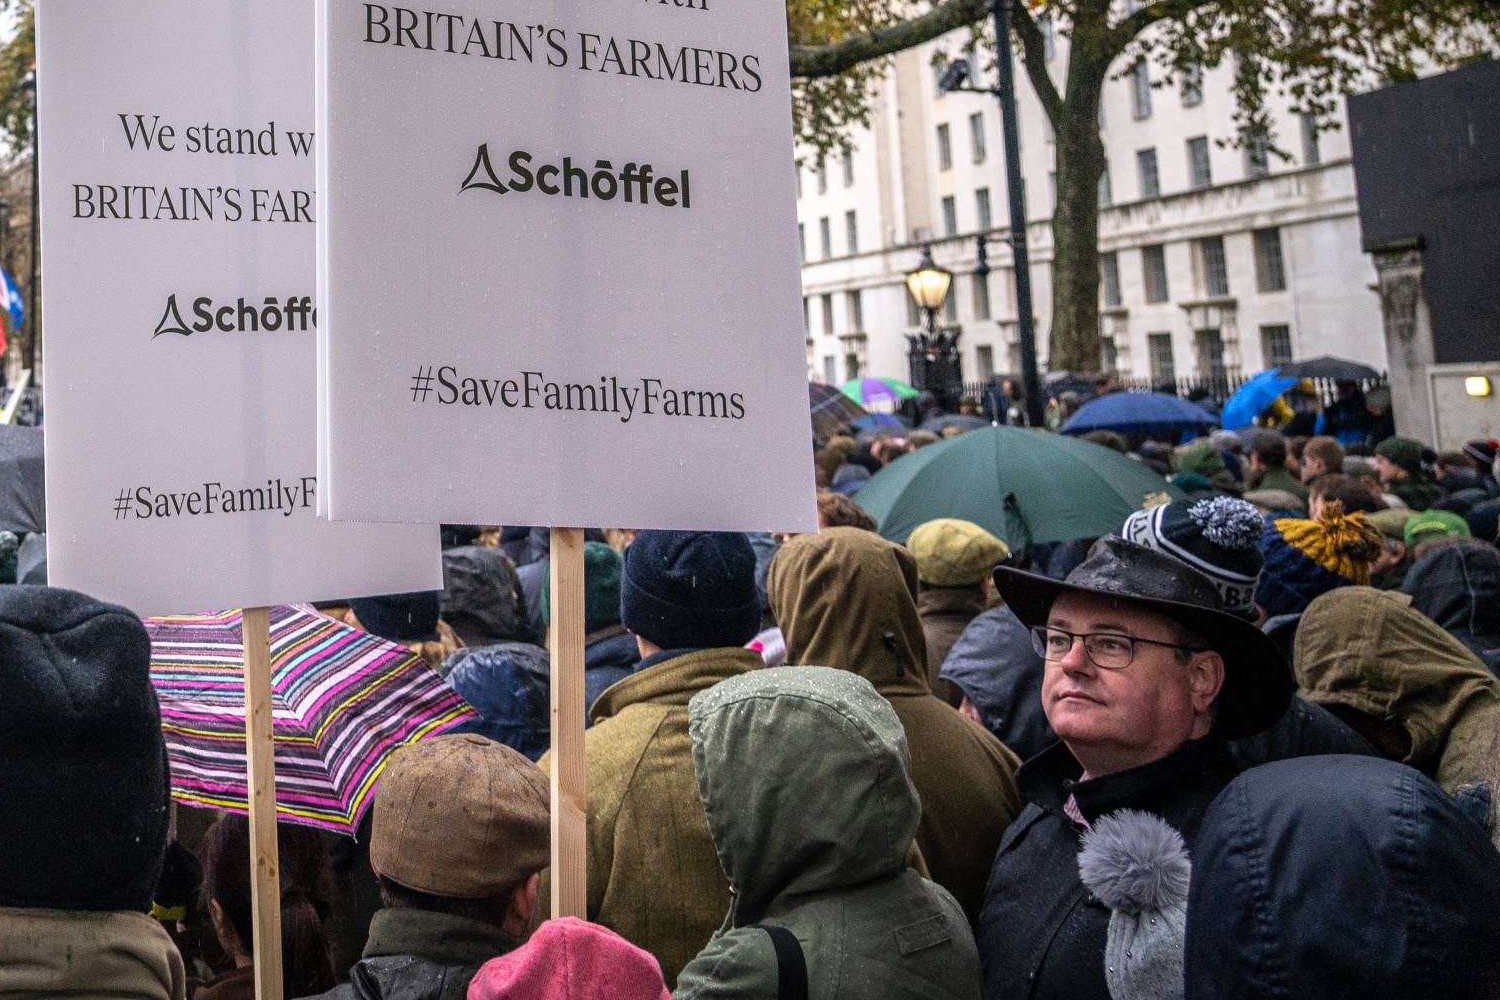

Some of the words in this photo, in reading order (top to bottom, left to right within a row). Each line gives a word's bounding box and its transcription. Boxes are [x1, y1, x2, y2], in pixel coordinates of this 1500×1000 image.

[362, 3, 568, 68] BRITAIN'S
[577, 32, 762, 93] FARMERS
[117, 113, 176, 151] We
[186, 121, 278, 156] stand
[285, 131, 315, 157] w
[72, 184, 242, 222] BRITAIN'S
[250, 189, 316, 223] FAR
[410, 365, 746, 424] #SaveFamilyFarms
[113, 476, 317, 520] #SaveFamilyF
